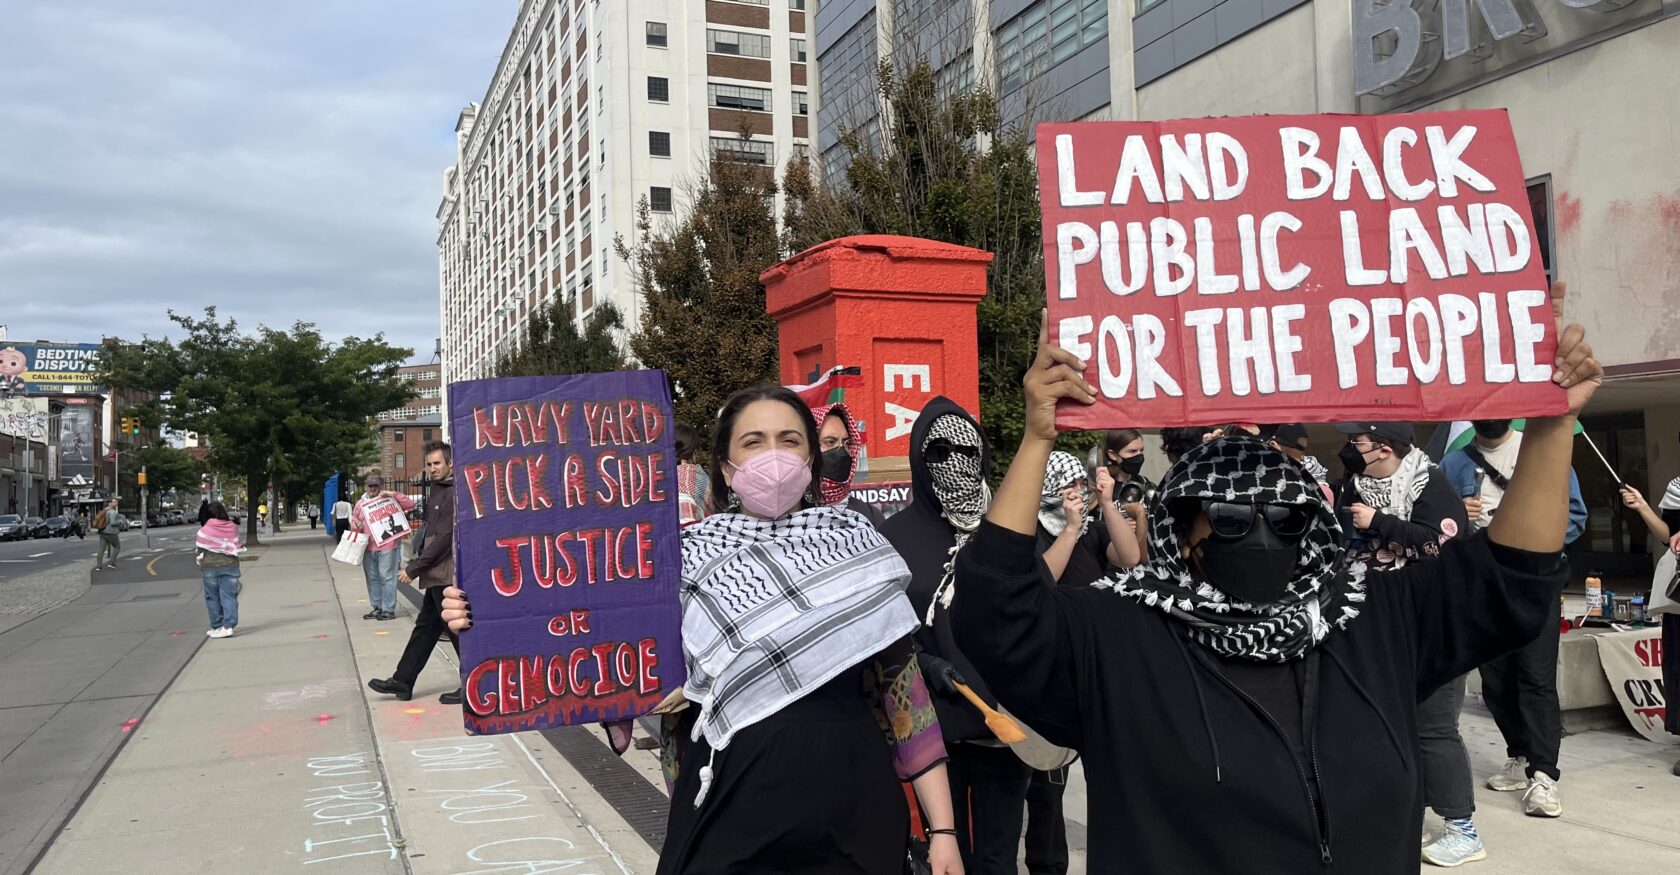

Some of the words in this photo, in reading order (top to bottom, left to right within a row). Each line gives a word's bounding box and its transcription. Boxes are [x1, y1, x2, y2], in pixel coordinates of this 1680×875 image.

[1055, 131, 1249, 207] LAND
[1278, 125, 1497, 201] BACK
[1056, 210, 1312, 299] PUBLIC
[1338, 203, 1532, 286] LAND
[34, 360, 103, 371] DISPUTE
[36, 348, 100, 360] BEDTIME
[1058, 313, 1184, 400] FOR
[1184, 303, 1313, 397] THE
[1328, 289, 1553, 390] PEOPLE
[473, 401, 571, 450] NAVY
[583, 398, 665, 447] YARD
[464, 453, 552, 518] PICK
[564, 455, 588, 509] A
[596, 449, 665, 508] SIDE
[491, 522, 655, 598] JUSTICE
[547, 609, 592, 636] OR
[306, 752, 371, 776] YOU
[303, 781, 397, 865] PROFIT
[426, 779, 545, 824] YOU
